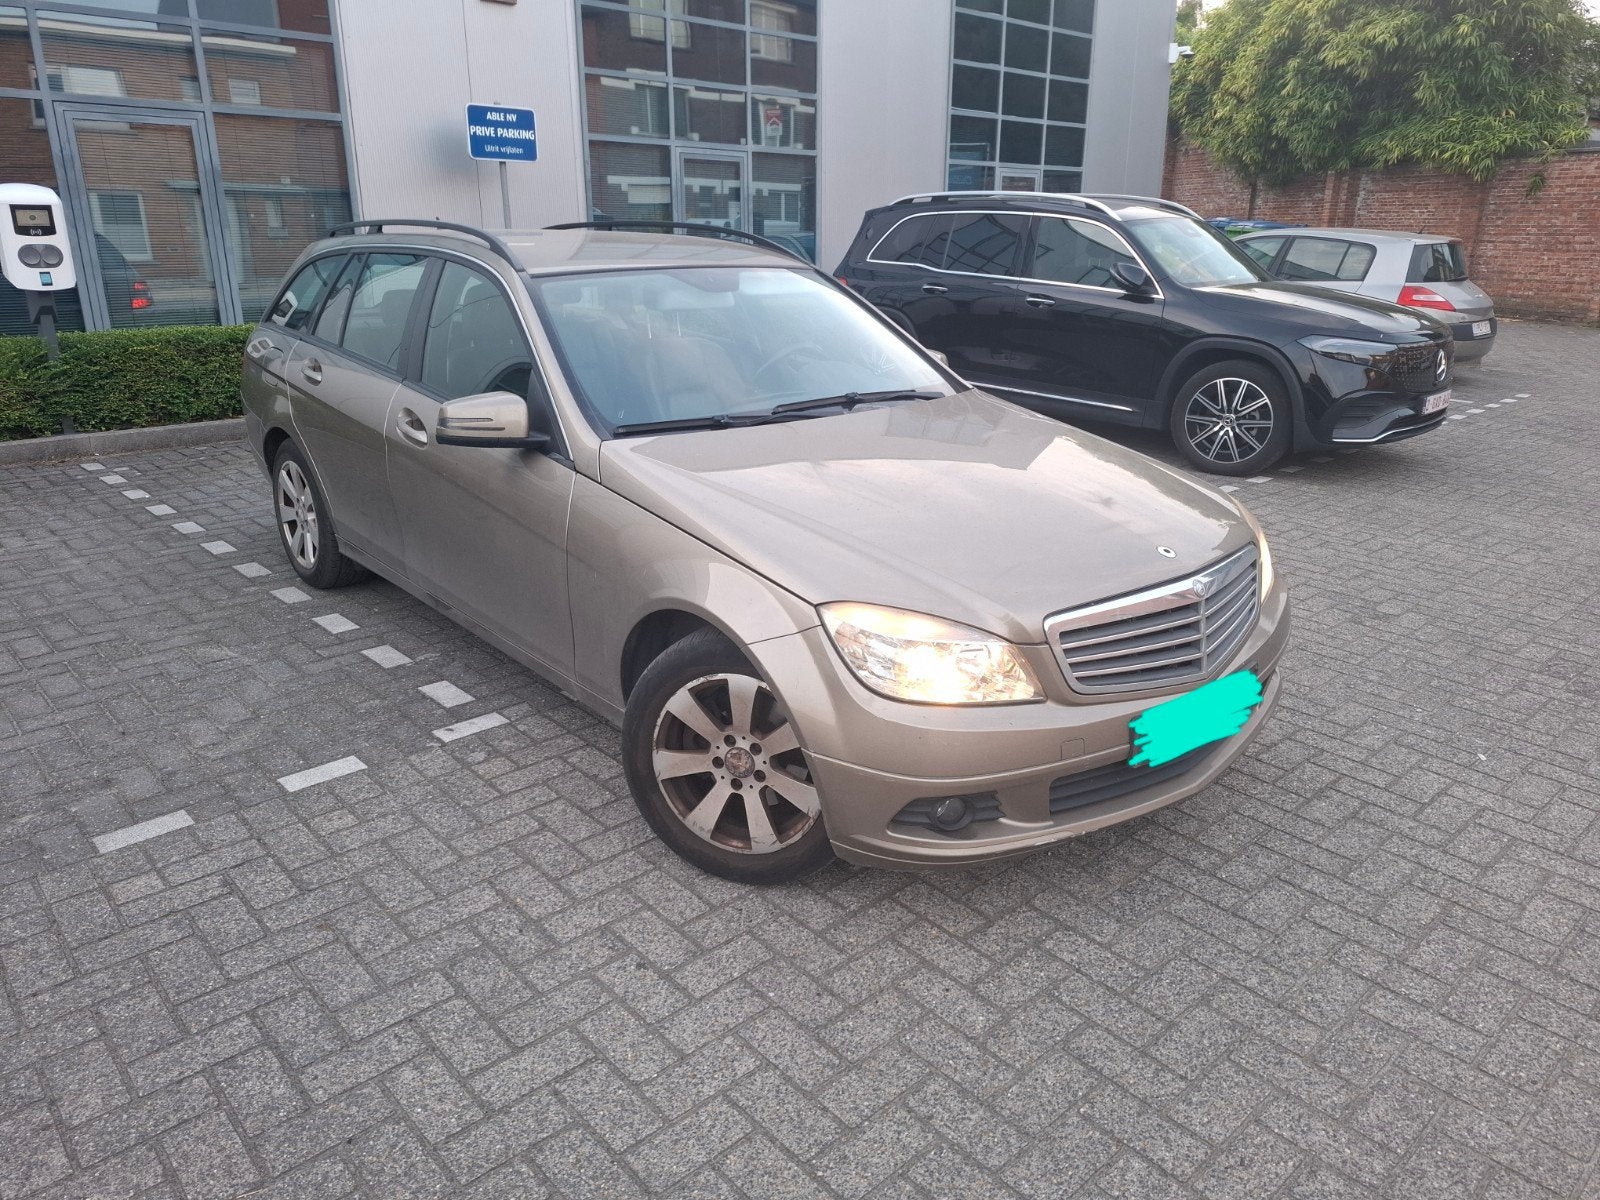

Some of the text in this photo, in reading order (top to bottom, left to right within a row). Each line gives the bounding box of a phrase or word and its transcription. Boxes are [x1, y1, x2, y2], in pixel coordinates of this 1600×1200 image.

[486, 111, 517, 122] ABLE NV
[470, 125, 535, 140] PRIVE PARKING
